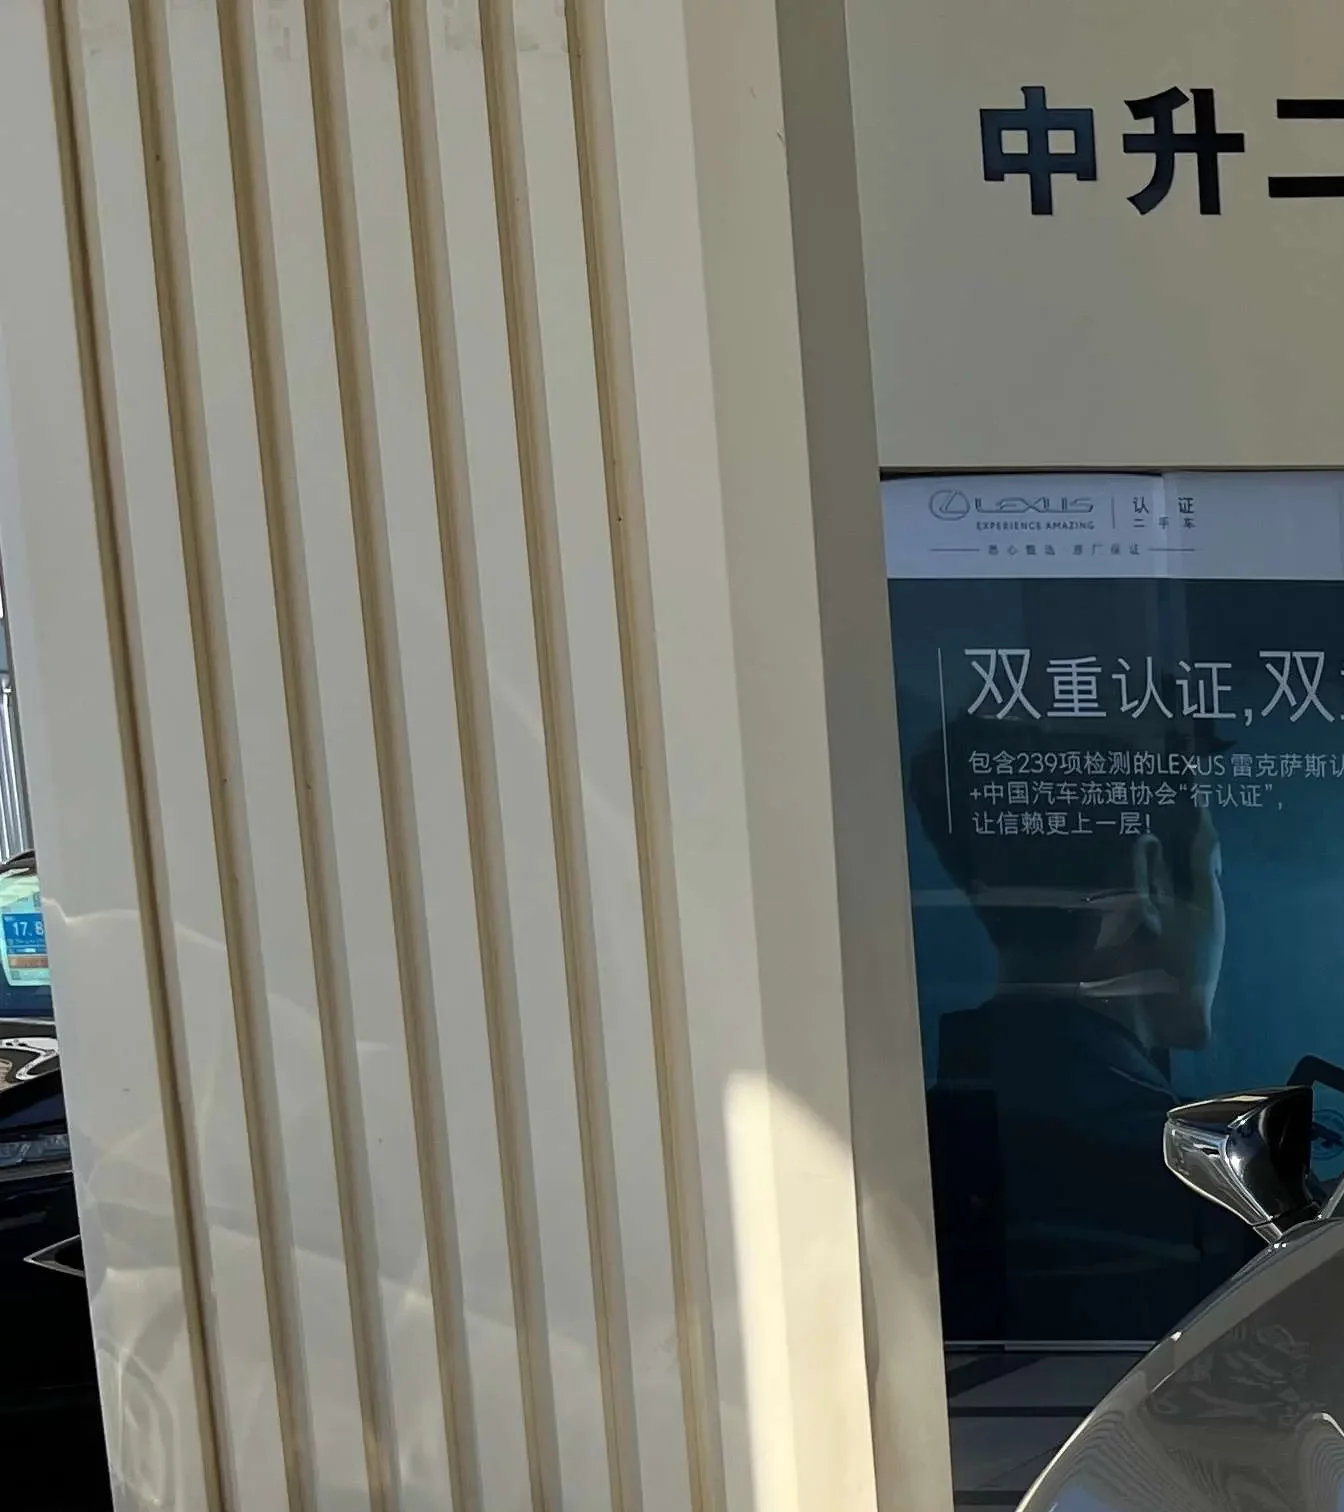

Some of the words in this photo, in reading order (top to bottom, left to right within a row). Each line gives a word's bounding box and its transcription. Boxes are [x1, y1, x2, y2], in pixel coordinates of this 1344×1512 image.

[974, 496, 1094, 514] LEXUS
[1132, 495, 1196, 515] 认证
[976, 521, 1042, 531] EXPERIENCE
[1046, 521, 1096, 531] AMAZING
[1133, 516, 1196, 529] 二手车
[968, 750, 1226, 776] 包含239项检测的LEXUS
